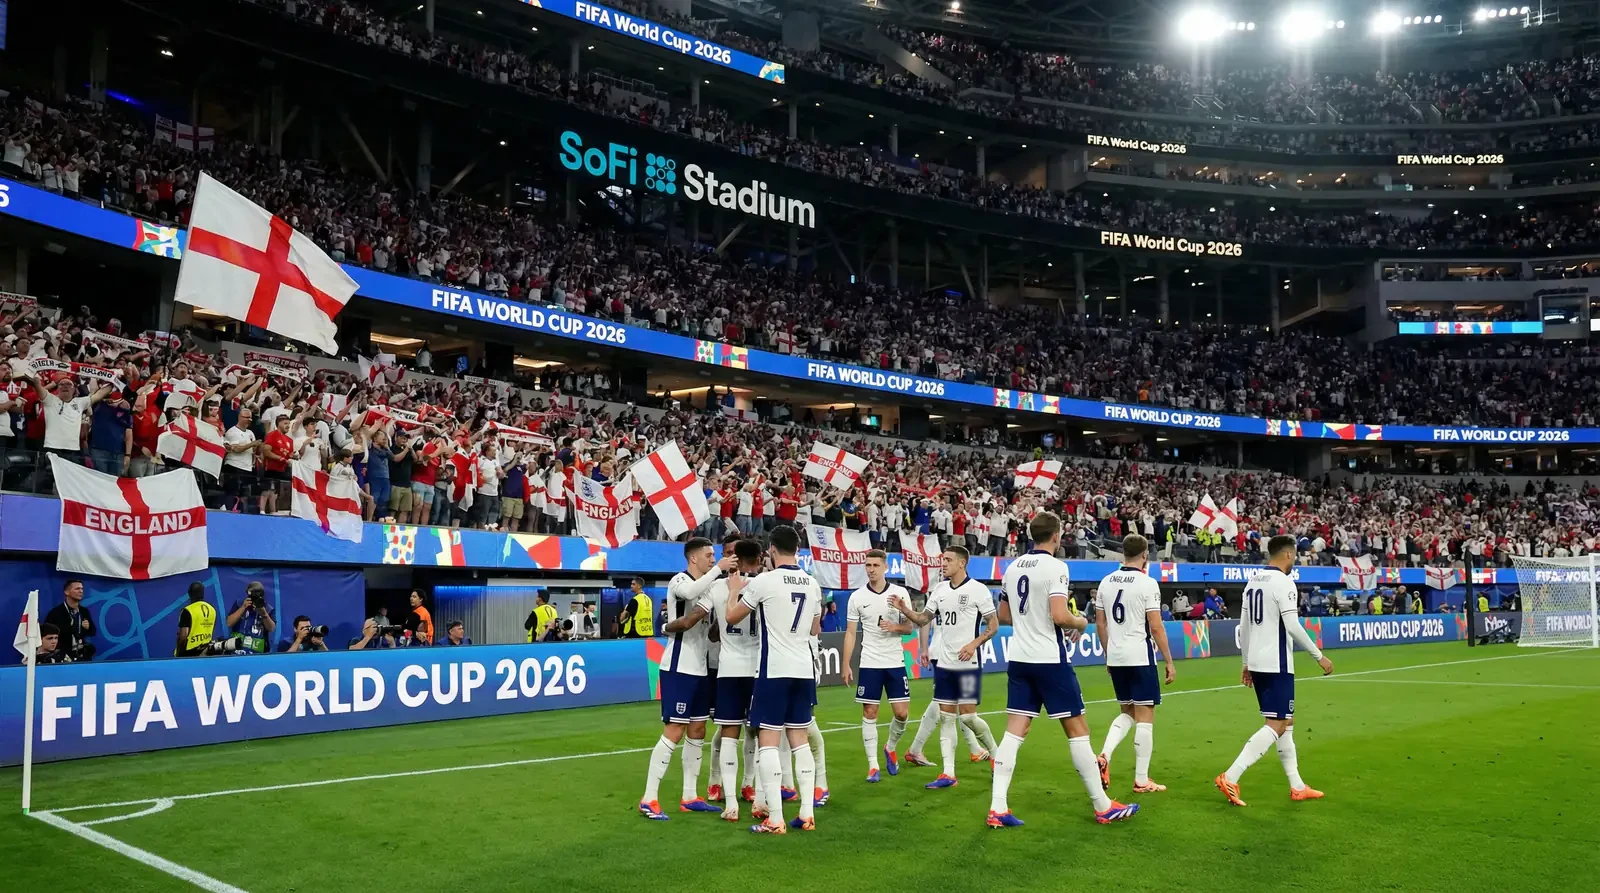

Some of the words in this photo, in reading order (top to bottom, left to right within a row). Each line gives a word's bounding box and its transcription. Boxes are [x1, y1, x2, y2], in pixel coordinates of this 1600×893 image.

[575, 1, 611, 26] FIFA
[614, 13, 659, 42] World
[662, 30, 692, 54] Cup
[694, 40, 732, 64] 2026
[1087, 134, 1109, 146] FIFA
[1110, 137, 1139, 149] World
[1140, 141, 1160, 153] Cup
[1397, 155, 1420, 164] FIFA
[1421, 155, 1452, 164] World
[1453, 154, 1475, 166] Cup
[1476, 154, 1504, 164] 2026
[559, 131, 637, 185] SoFi
[683, 163, 815, 229] Stadium
[1101, 231, 1131, 247] FIFA
[1133, 234, 1175, 251] World
[1177, 238, 1204, 256] Cup
[1207, 241, 1242, 257] 2026
[432, 289, 473, 314] FIFA
[477, 298, 545, 328] WORLD
[548, 314, 583, 335] CUP
[586, 322, 626, 344] 2026
[808, 362, 836, 380] FIFA
[838, 367, 886, 387] WORLD
[888, 376, 913, 391] CUP
[915, 380, 945, 396] 2026
[1104, 405, 1128, 419] FIFA
[1130, 408, 1169, 423] WORLD
[1171, 413, 1193, 425] CUP
[1194, 415, 1221, 428] 2026
[1433, 429, 1459, 440] FIFA
[1461, 429, 1507, 441] WORLD
[1509, 430, 1536, 441] CUP
[1538, 430, 1570, 441] 2026
[817, 457, 853, 478] ENGLAND
[582, 498, 633, 519] ENGLAN
[85, 507, 192, 535] ENGLAND
[820, 551, 866, 564] ENGLAND
[1223, 567, 1242, 580] FIFA
[1017, 574, 1030, 615] 9
[1246, 588, 1264, 625] 10
[791, 592, 806, 634] 7
[945, 611, 957, 626] 20
[1112, 589, 1126, 625] 6
[1340, 623, 1362, 641] FIFA
[1363, 621, 1400, 640] WORLD
[1401, 620, 1420, 638] CUP
[1421, 618, 1444, 637] 2026
[1546, 616, 1563, 631] FIFA
[1564, 614, 1592, 630] WORLD
[41, 679, 179, 742] FIFA
[191, 667, 385, 726] WORLD
[397, 662, 486, 708] CUP
[495, 654, 587, 700] 2026
